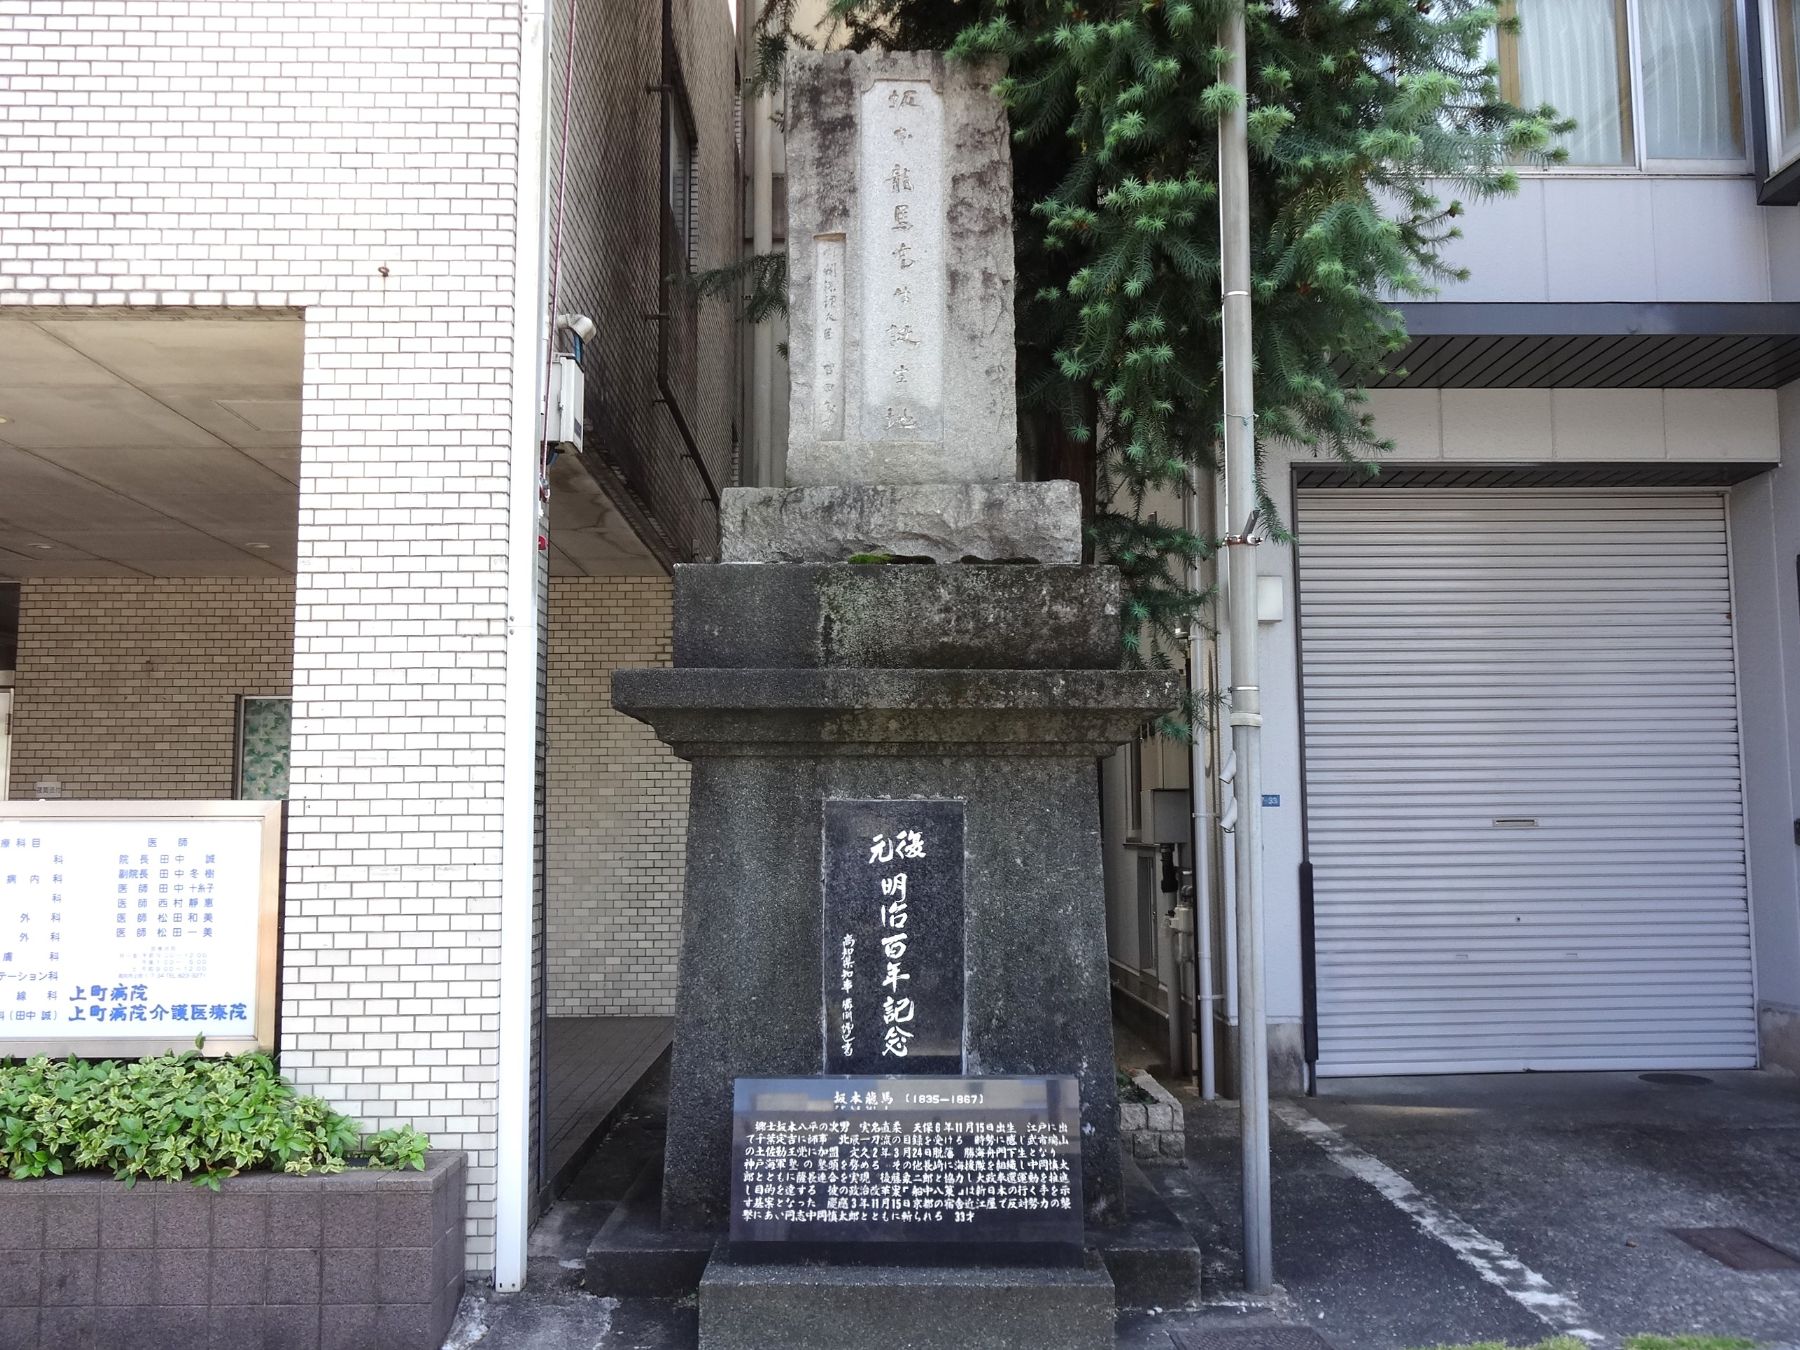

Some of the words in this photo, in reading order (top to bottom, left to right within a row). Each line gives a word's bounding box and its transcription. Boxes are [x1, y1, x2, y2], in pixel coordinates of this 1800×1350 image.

[881, 873, 914, 1056] 明治百年記念
[834, 1092, 893, 1105] 坂本龍馬
[1027, 1123, 1067, 1132] 江戸に出
